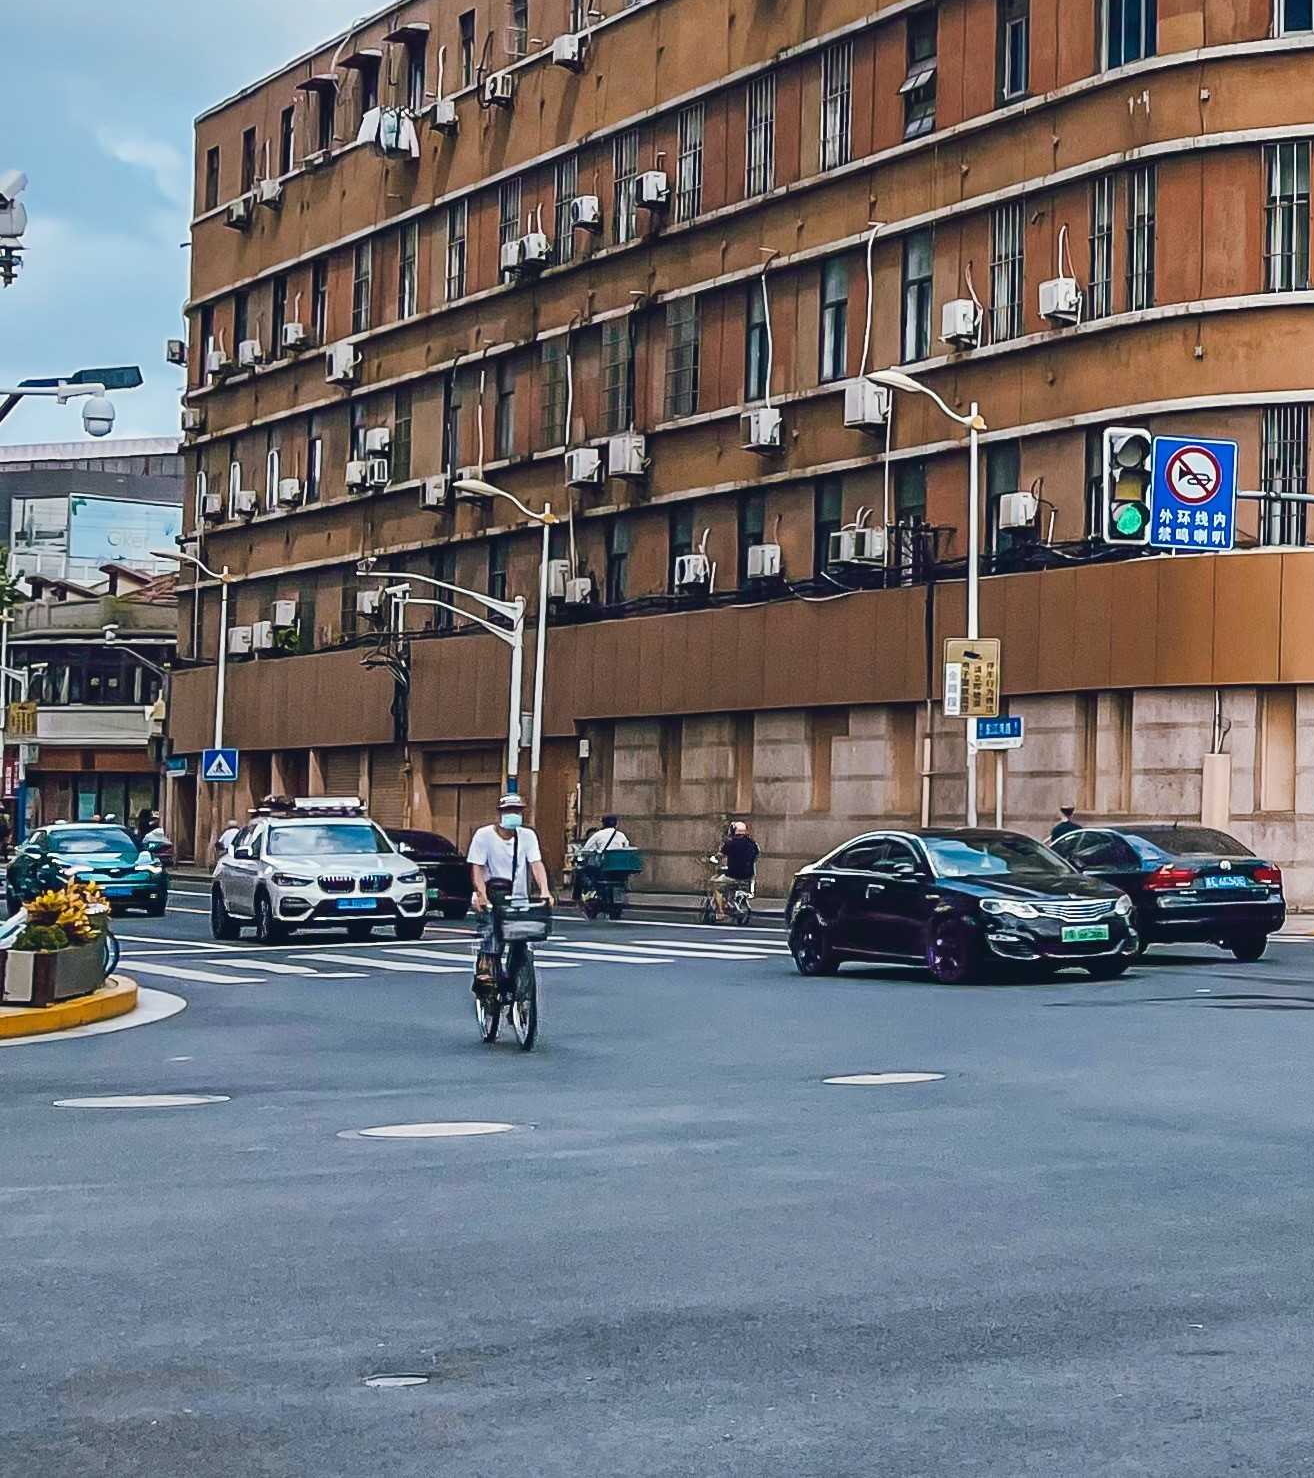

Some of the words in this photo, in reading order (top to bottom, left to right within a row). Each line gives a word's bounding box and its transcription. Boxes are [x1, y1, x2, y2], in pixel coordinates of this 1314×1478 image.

[1159, 508, 1226, 528] 外环线内
[1158, 526, 1226, 546] 禁鸣喇叭
